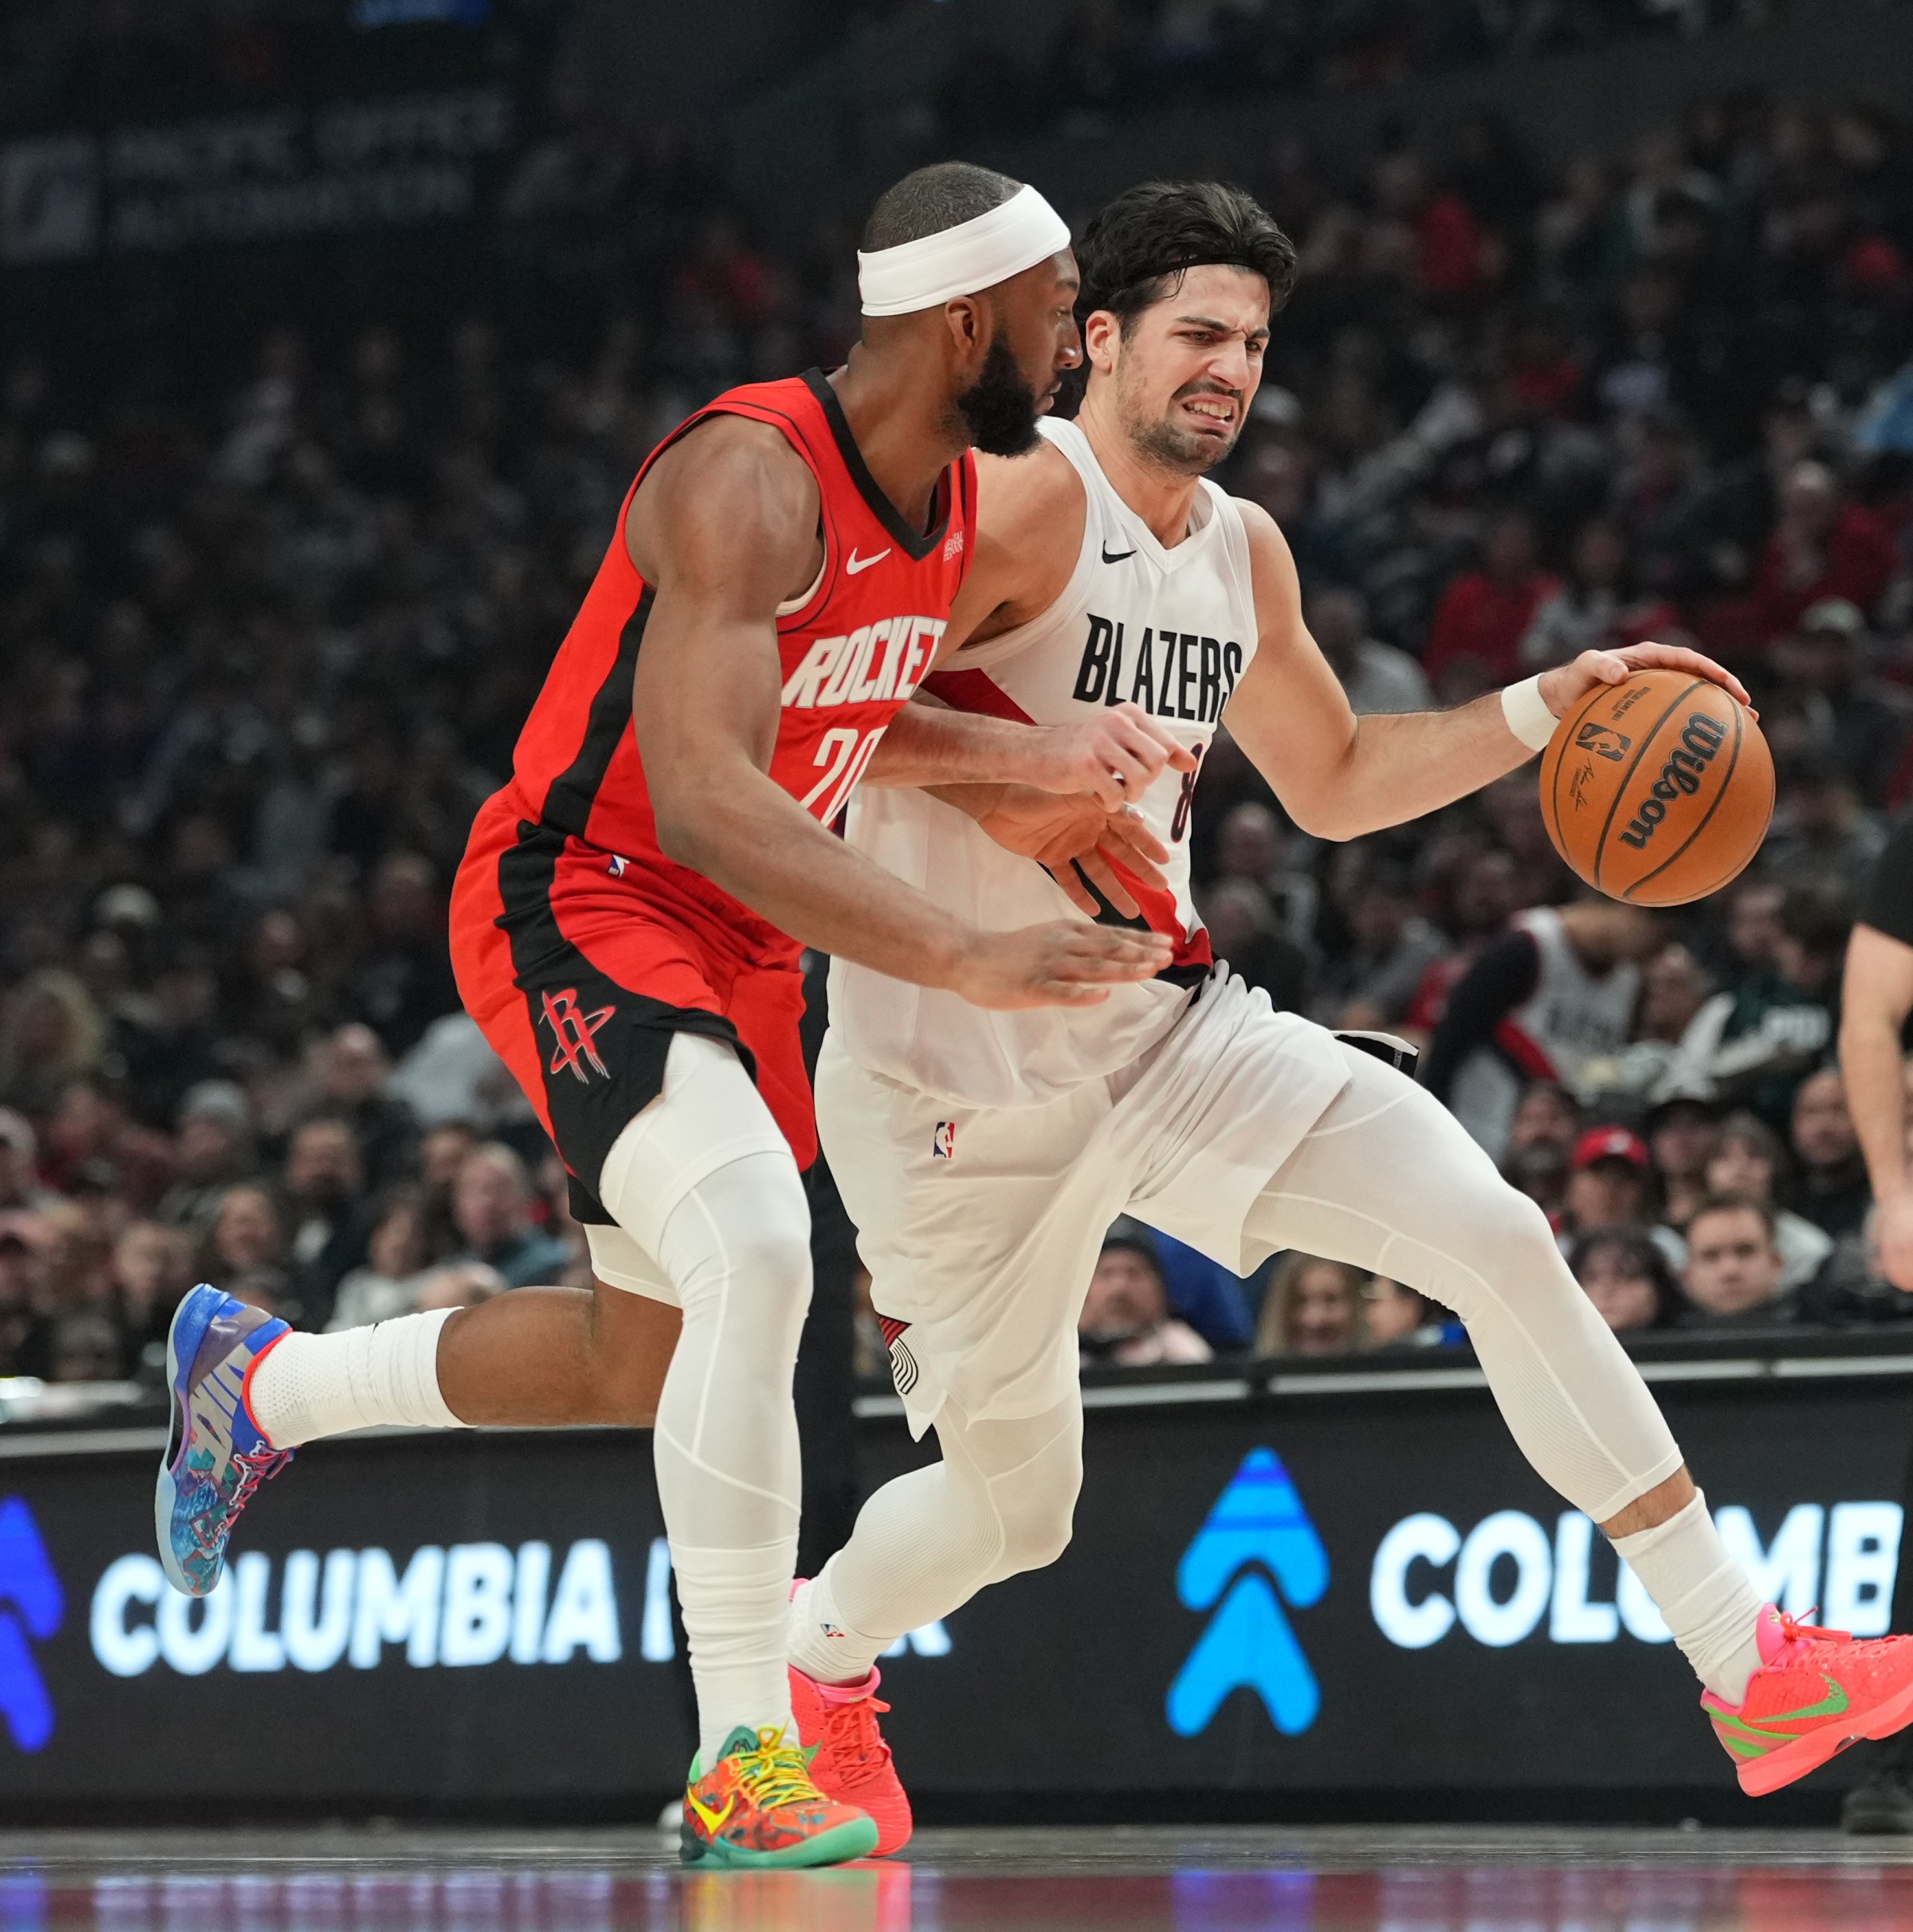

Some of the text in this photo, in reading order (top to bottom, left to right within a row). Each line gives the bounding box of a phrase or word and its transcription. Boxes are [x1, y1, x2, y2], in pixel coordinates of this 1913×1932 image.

[1073, 613, 1242, 723] BLAZERS
[799, 724, 889, 828] 20
[1619, 713, 1728, 850] Wilson
[89, 1537, 623, 1677] COLUMBIA
